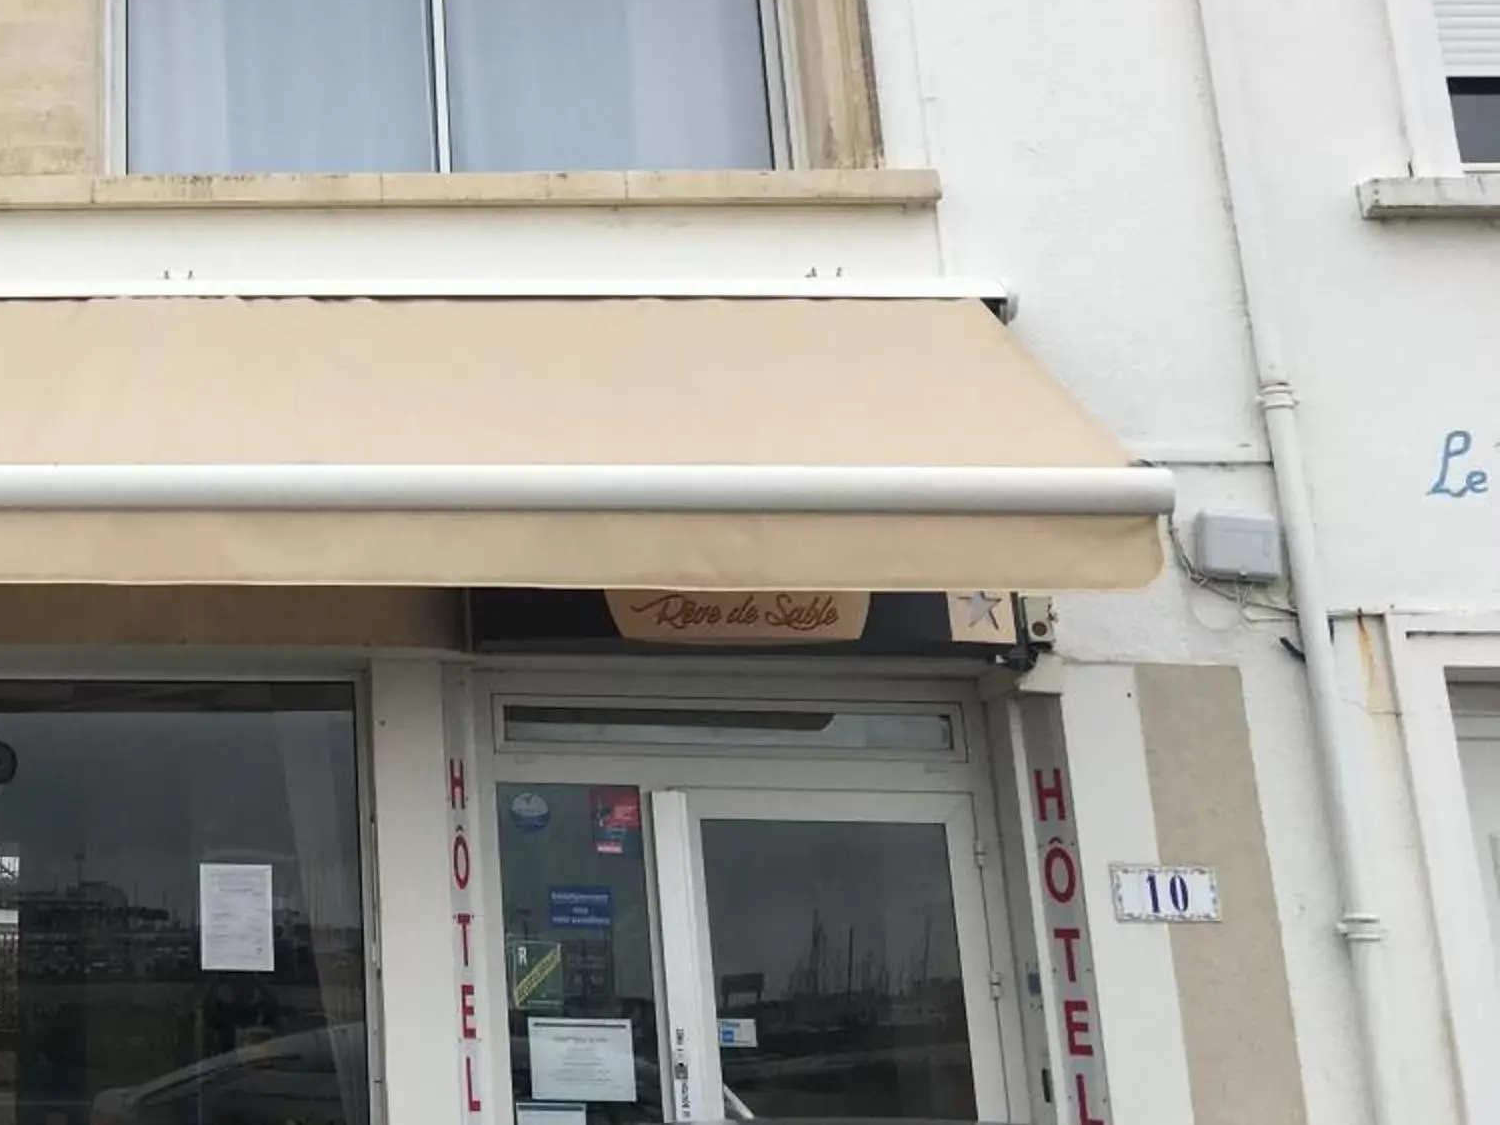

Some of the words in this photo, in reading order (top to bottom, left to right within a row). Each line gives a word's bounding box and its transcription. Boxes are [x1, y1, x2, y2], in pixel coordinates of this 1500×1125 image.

[726, 594, 759, 626] de
[765, 593, 840, 631] Sable
[448, 758, 481, 1113] HÔTEL
[1034, 768, 1104, 1125] HÔTEL
[1146, 873, 1190, 914] 10
